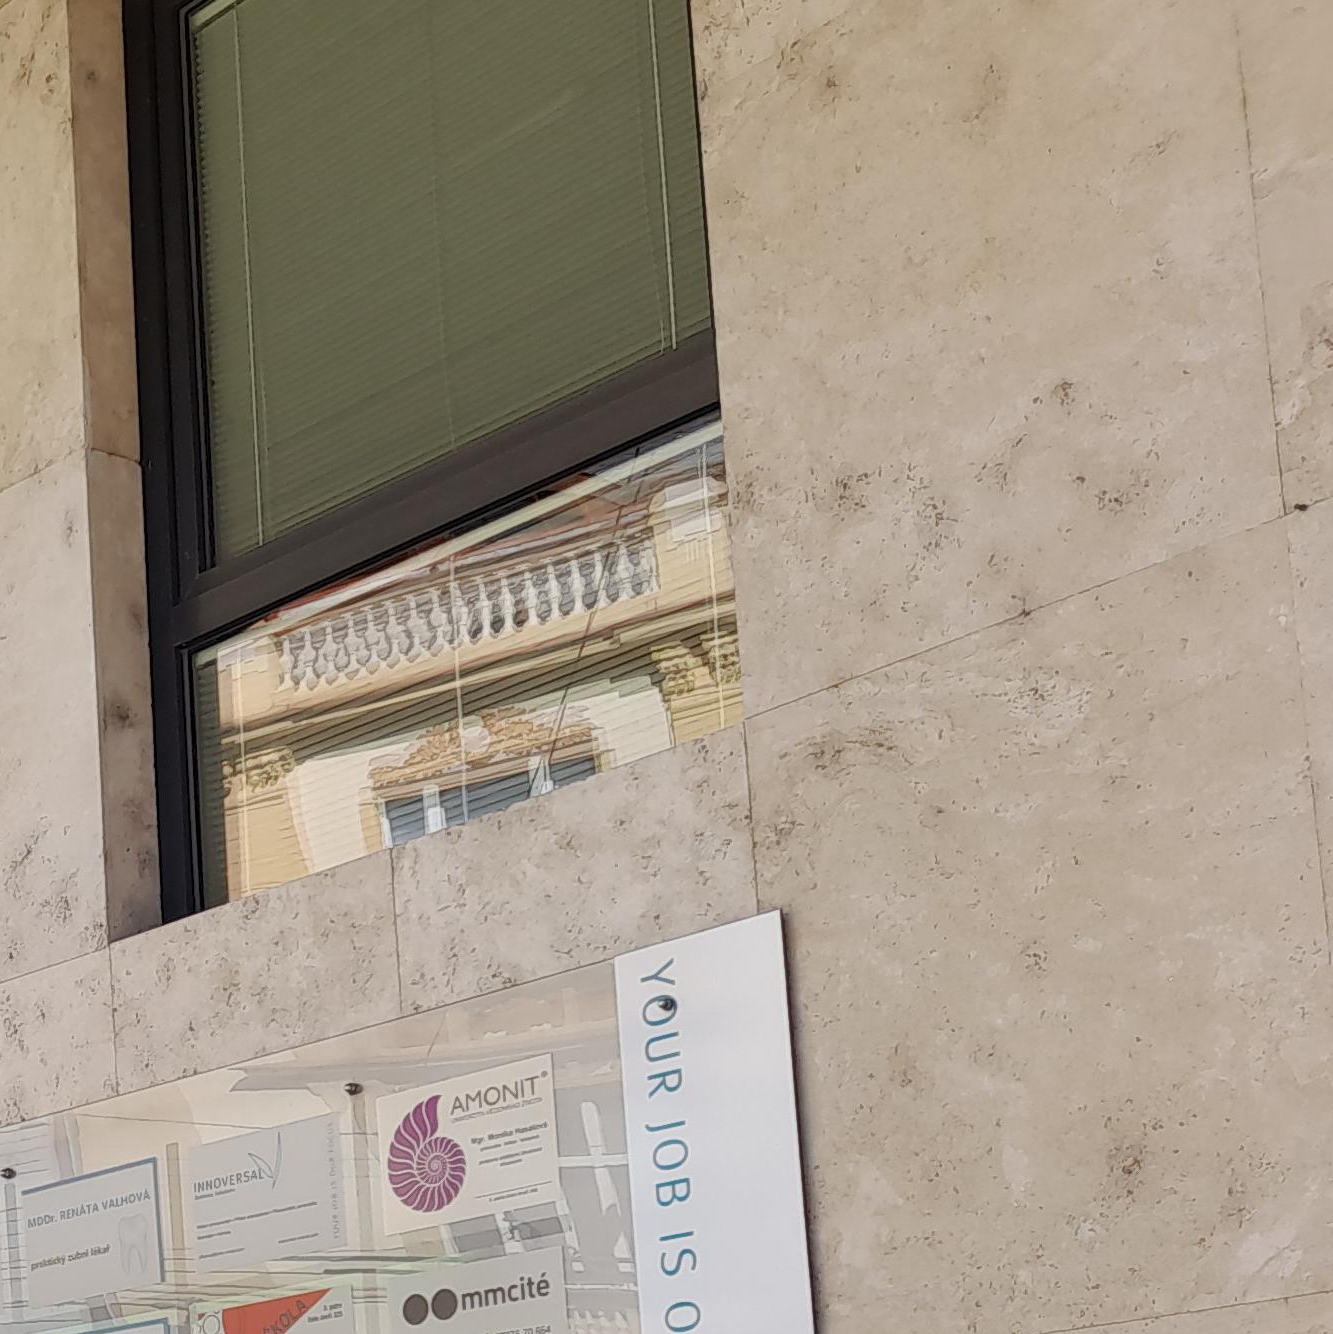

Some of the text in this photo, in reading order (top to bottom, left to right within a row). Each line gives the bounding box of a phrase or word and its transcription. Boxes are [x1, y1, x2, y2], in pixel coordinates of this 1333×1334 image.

[640, 958, 683, 1099] YOUR
[450, 1075, 539, 1115] AMONIT
[194, 1170, 264, 1193] INNOVERSAL
[645, 1120, 691, 1207] JOB
[60, 1201, 99, 1221] RENÁTA
[102, 1188, 151, 1211] VALHOVÁ
[659, 1231, 697, 1276] IS
[461, 1272, 550, 1311] mmcité
